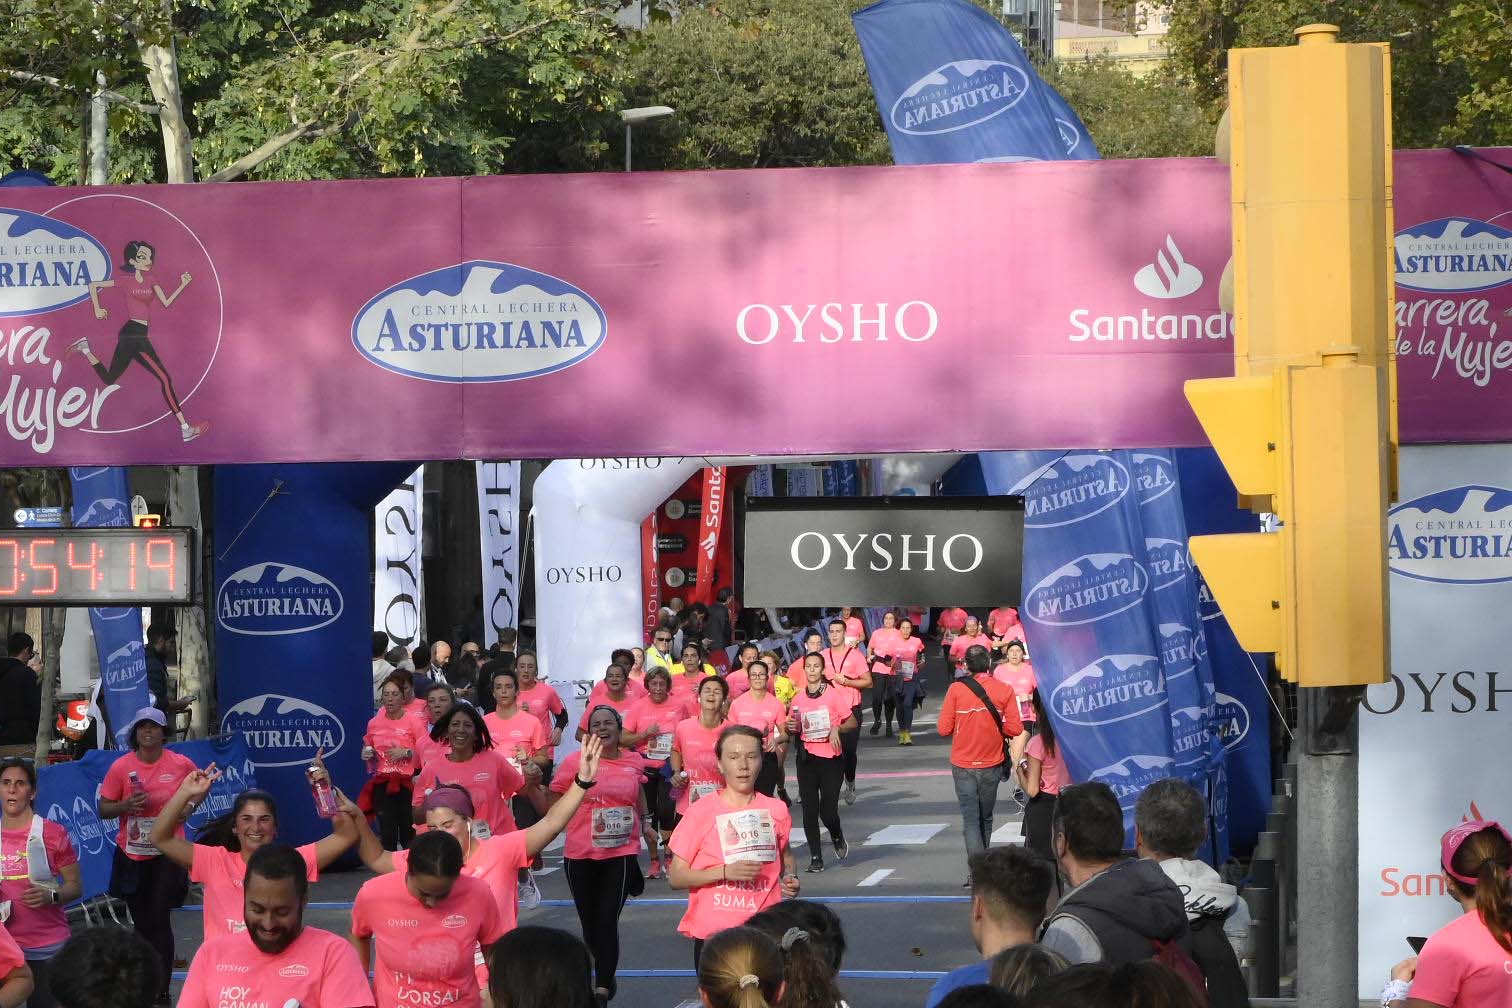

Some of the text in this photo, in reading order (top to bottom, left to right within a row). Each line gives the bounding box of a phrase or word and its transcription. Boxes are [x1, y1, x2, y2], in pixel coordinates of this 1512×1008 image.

[15, 244, 86, 256] LECHERA
[1409, 242, 1510, 251] CENTRAL LECHER
[411, 302, 579, 316] CENTRAL LECHERA
[1395, 299, 1489, 327] arrera
[372, 308, 588, 353] ASTURIANA
[736, 301, 938, 345] OYSHO
[1069, 309, 1236, 341] Santand
[1418, 328, 1435, 355] la
[1432, 323, 1512, 387] Muje
[1416, 519, 1483, 530] CENTRAL
[1389, 523, 1512, 560] ASTURI
[791, 532, 983, 572] OYSHO
[547, 565, 622, 584] OYSHO
[234, 587, 329, 596] CENTRAL LECHERA
[222, 592, 334, 619] ASTURIANA
[236, 718, 330, 727] CENTRAL LECHERA
[244, 730, 335, 748] TURIANA
[713, 894, 757, 909] SUMA
[388, 919, 419, 927] OYSHO
[219, 987, 250, 999] HOY
